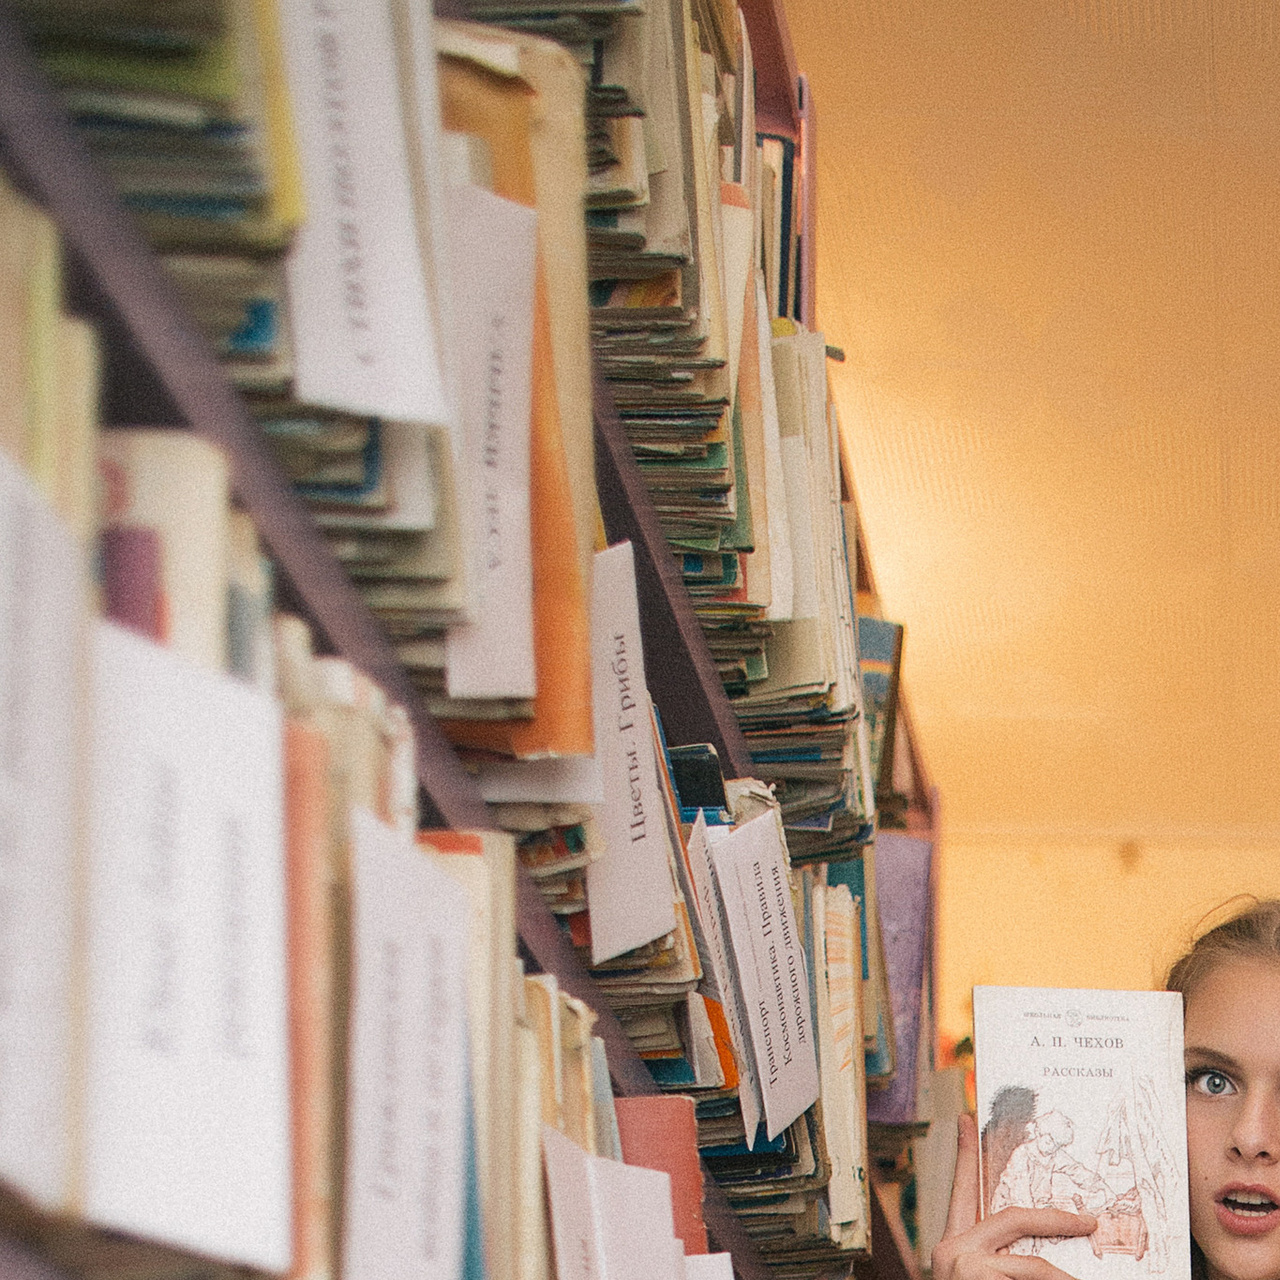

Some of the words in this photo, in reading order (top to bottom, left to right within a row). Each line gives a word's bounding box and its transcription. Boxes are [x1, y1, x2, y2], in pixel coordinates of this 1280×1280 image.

[611, 632, 637, 732] Грибы
[626, 742, 648, 844] Цветы.
[752, 861, 772, 937] Правила
[771, 860, 794, 952] движения.
[757, 999, 778, 1088] Транспорт
[769, 939, 793, 1066] Космонавтика.
[785, 954, 807, 1044] дорожного
[1030, 1035, 1045, 1047] А.
[1052, 1036, 1066, 1048] П.
[1074, 1036, 1124, 1049] ЧЕХОВ
[1043, 1066, 1113, 1078] РАССКАЗЫ
